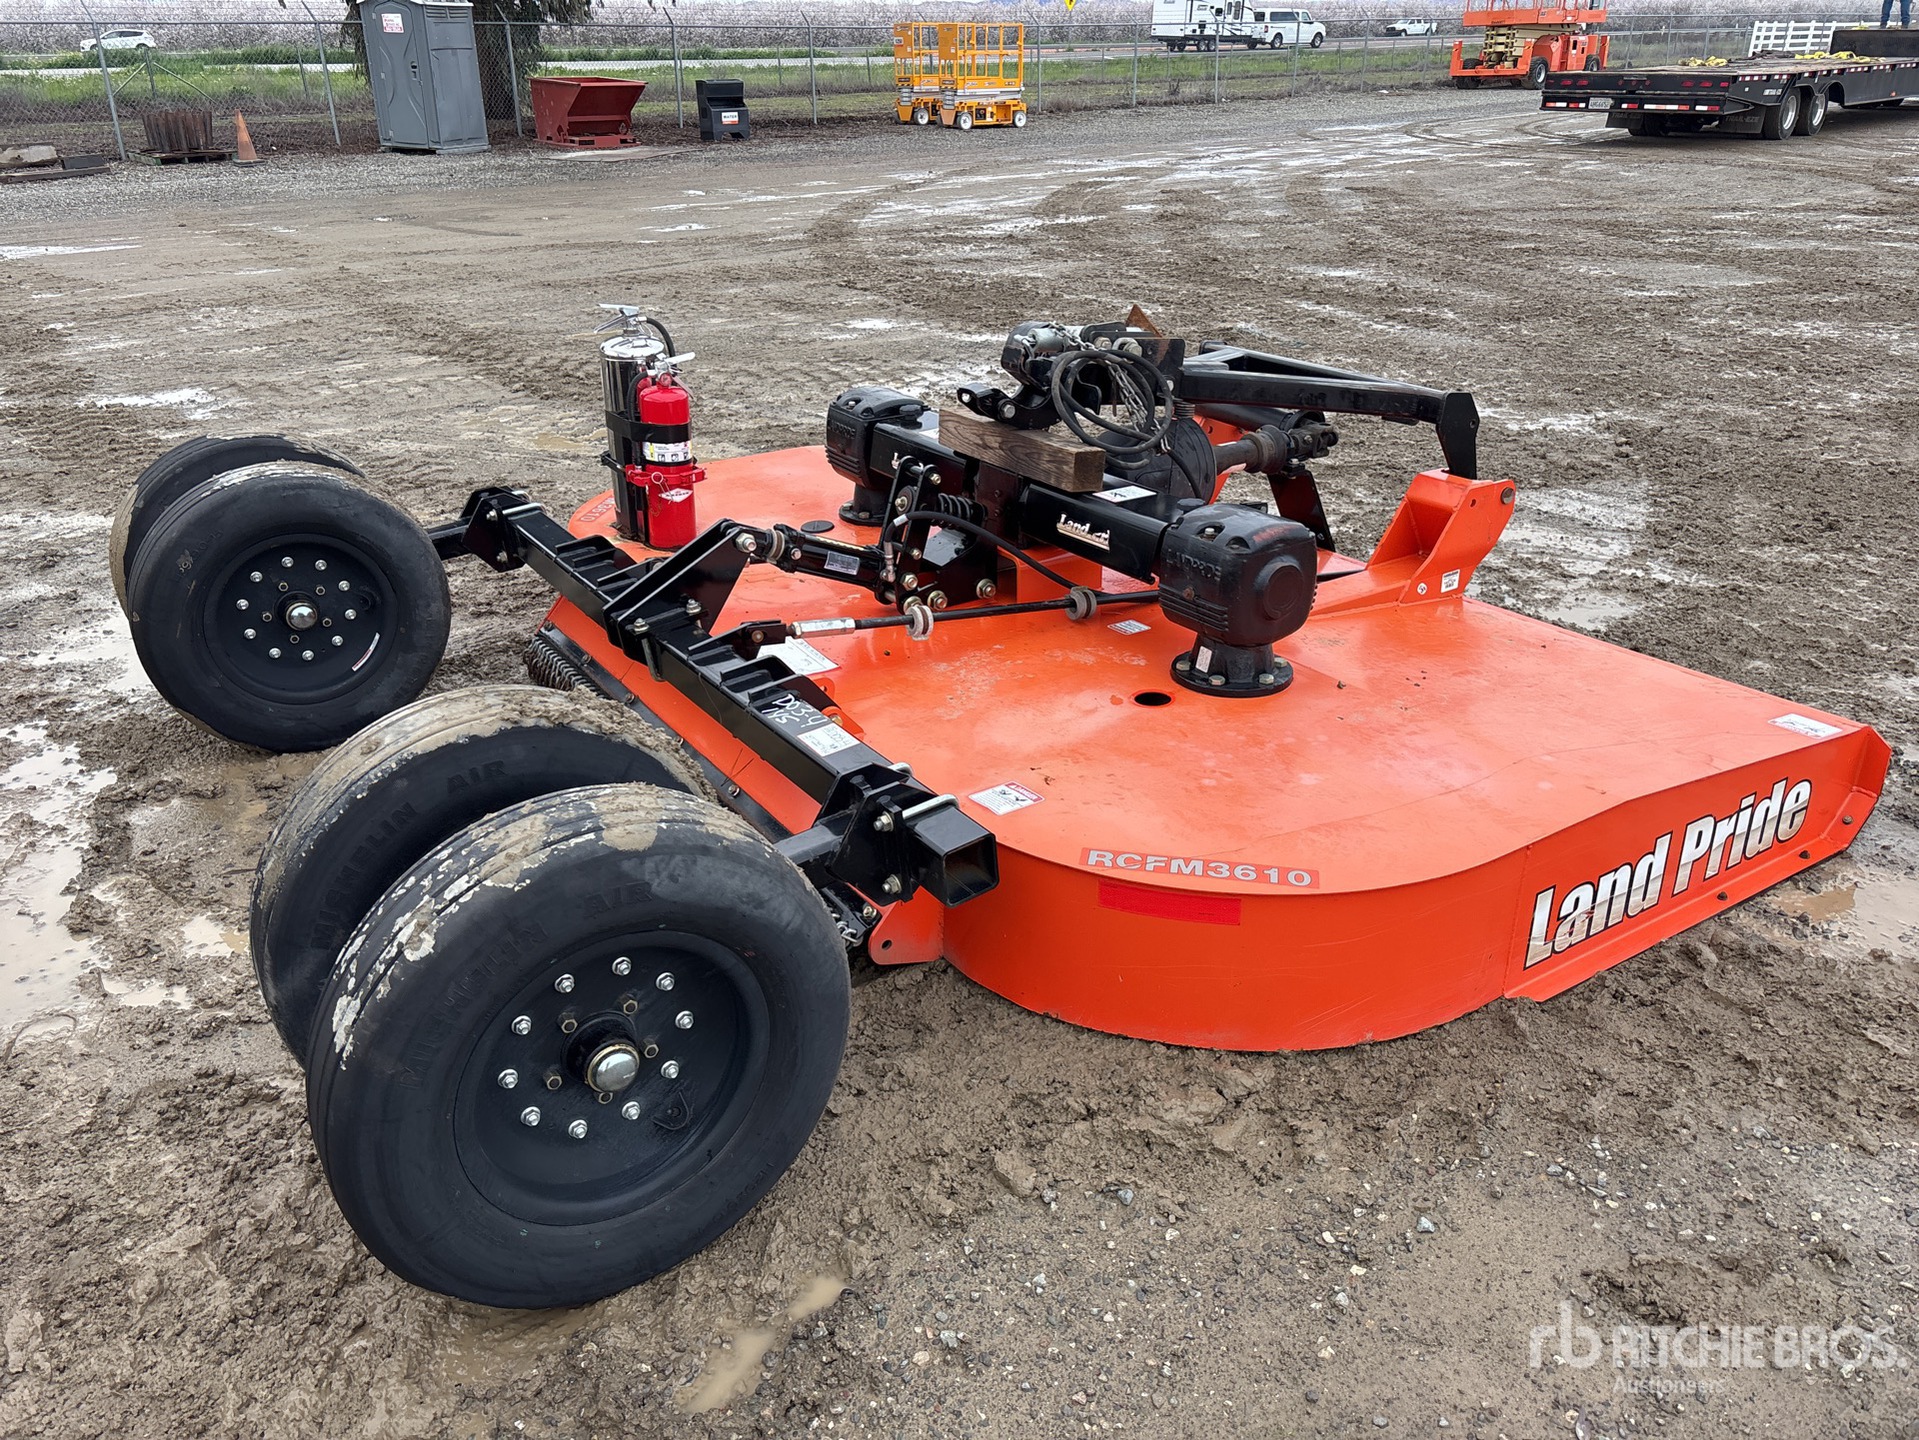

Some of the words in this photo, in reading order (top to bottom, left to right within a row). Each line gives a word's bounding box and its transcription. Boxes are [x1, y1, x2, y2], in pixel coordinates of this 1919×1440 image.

[309, 801, 420, 950] MICHELIN
[445, 760, 509, 794] AIR
[583, 881, 654, 918] AIR
[1086, 849, 1314, 888] RCFM3610
[1523, 831, 1673, 971] Land
[1672, 777, 1813, 896] Pride
